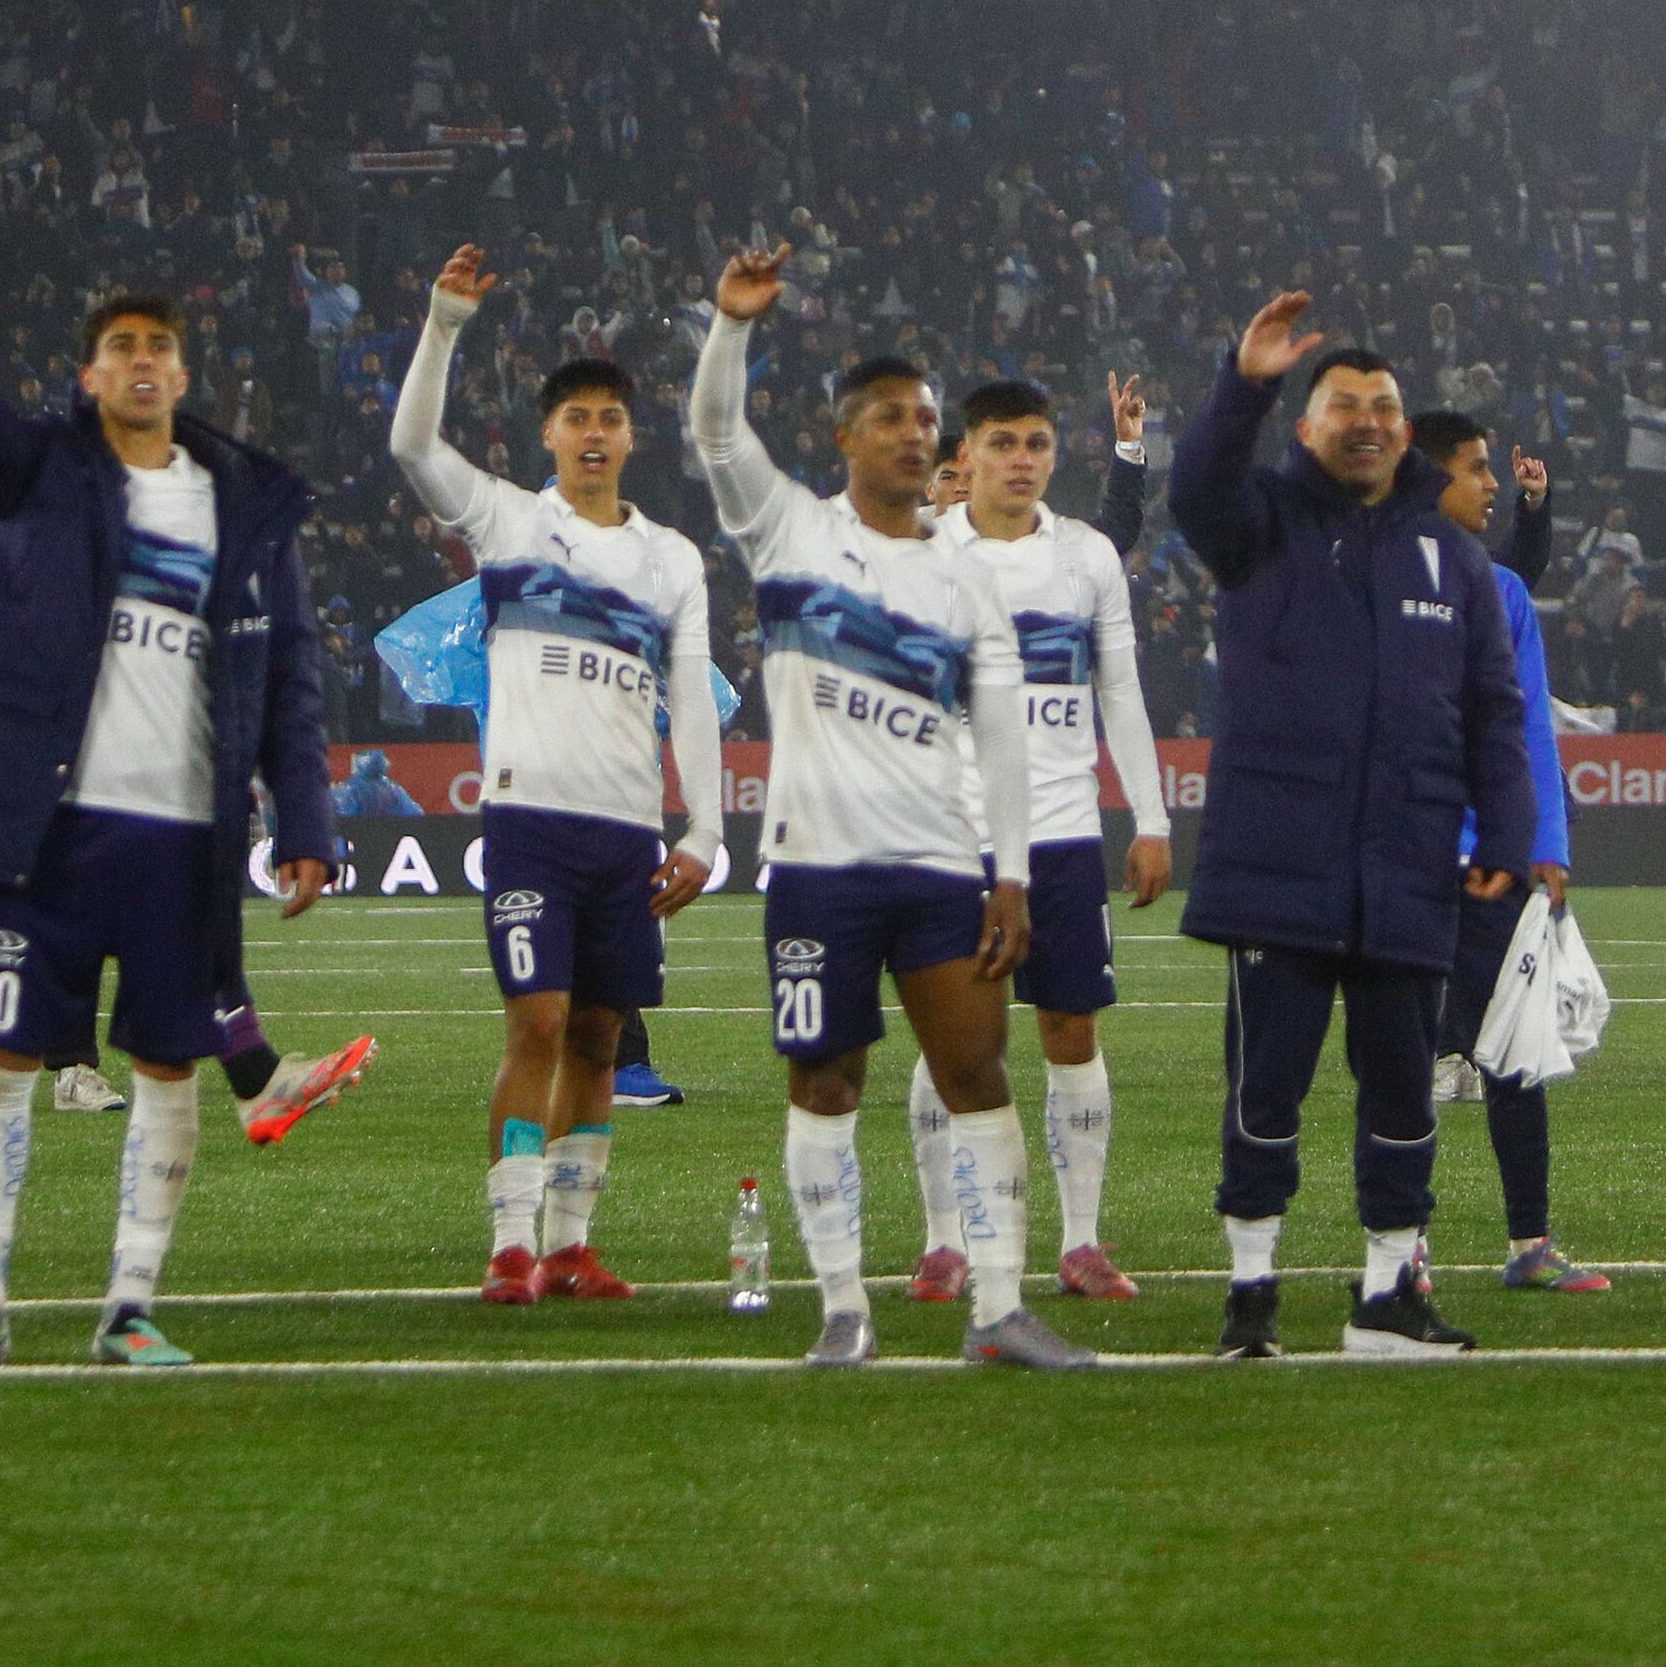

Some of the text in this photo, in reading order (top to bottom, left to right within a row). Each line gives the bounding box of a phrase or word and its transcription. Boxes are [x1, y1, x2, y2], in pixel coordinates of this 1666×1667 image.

[111, 611, 204, 660] BICE
[1418, 601, 1453, 621] BICE
[580, 650, 654, 701] BICE
[848, 686, 940, 747] BICE
[1027, 697, 1080, 729] ICE
[507, 924, 536, 981] 6
[776, 978, 822, 1040] 20
